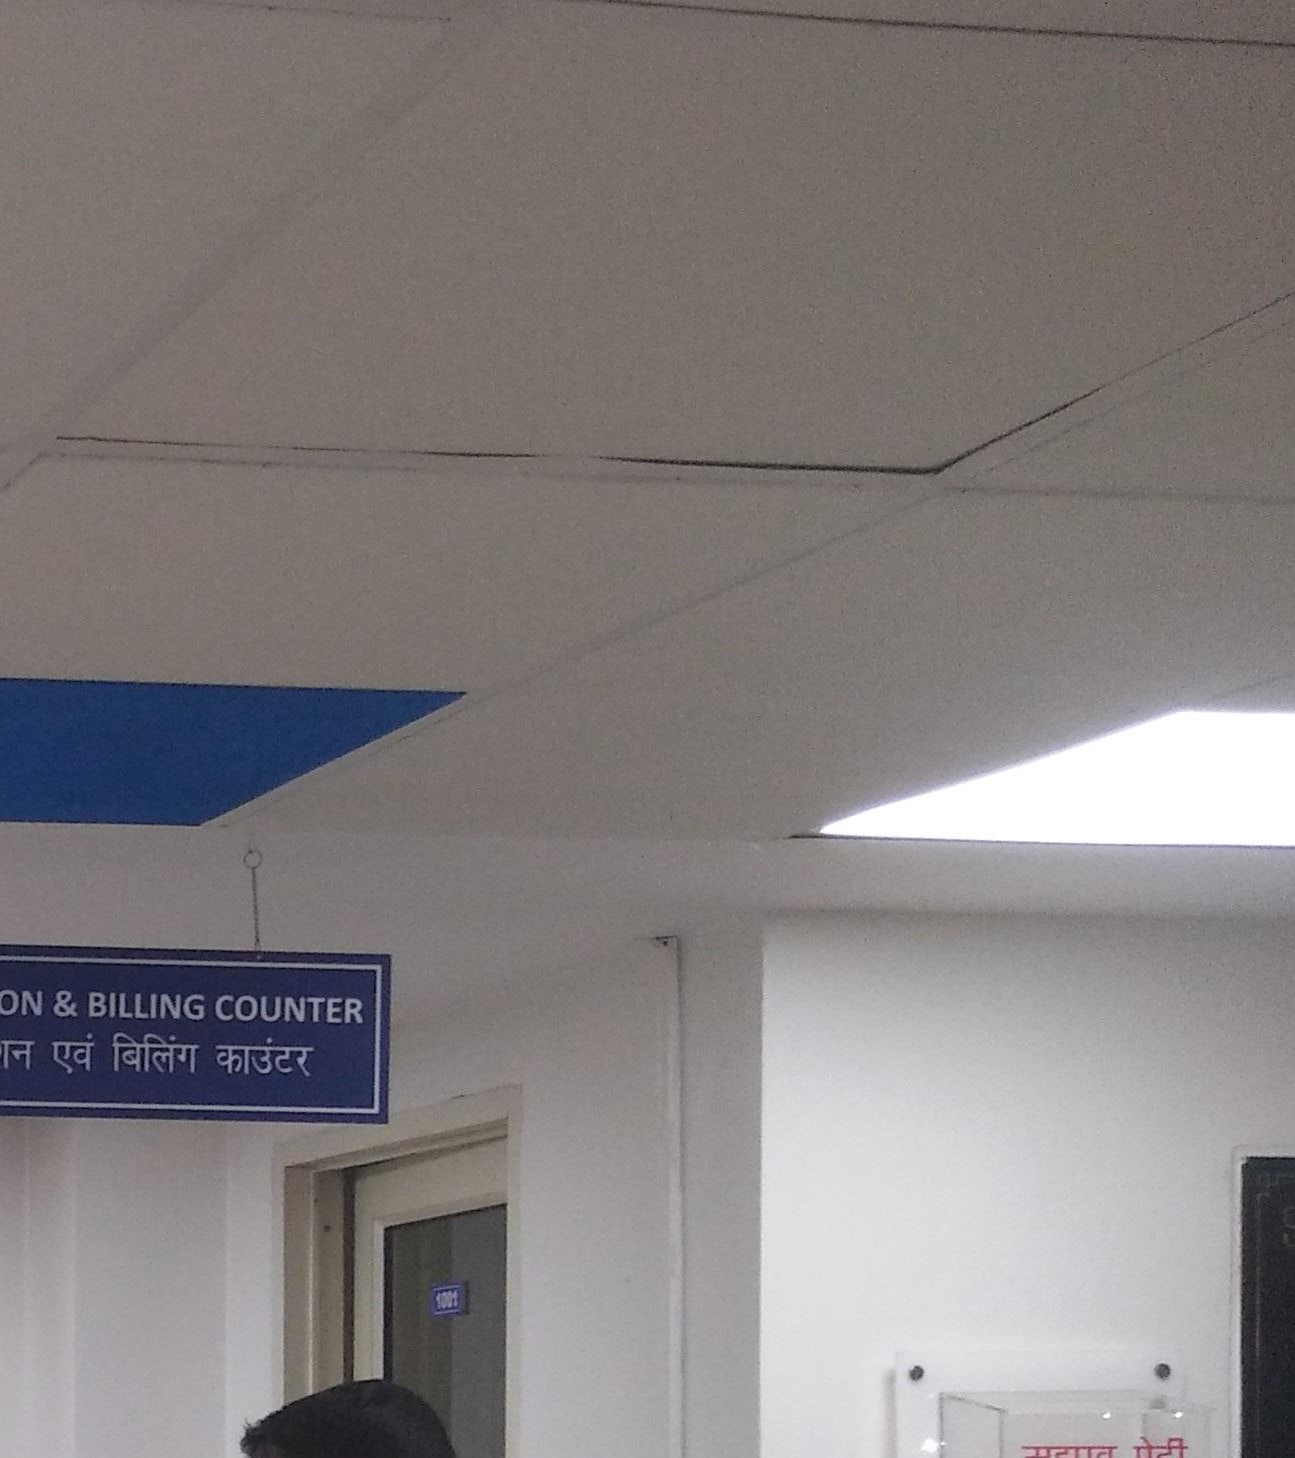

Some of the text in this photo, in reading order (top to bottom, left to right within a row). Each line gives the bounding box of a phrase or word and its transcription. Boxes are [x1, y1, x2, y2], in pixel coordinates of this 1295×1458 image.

[53, 990, 78, 1017] &
[88, 992, 205, 1021] BILLING
[215, 994, 364, 1024] COUNTER
[51, 1032, 95, 1074] एवं
[112, 1032, 200, 1074] बिलिंग
[215, 1036, 314, 1077] काउंटर
